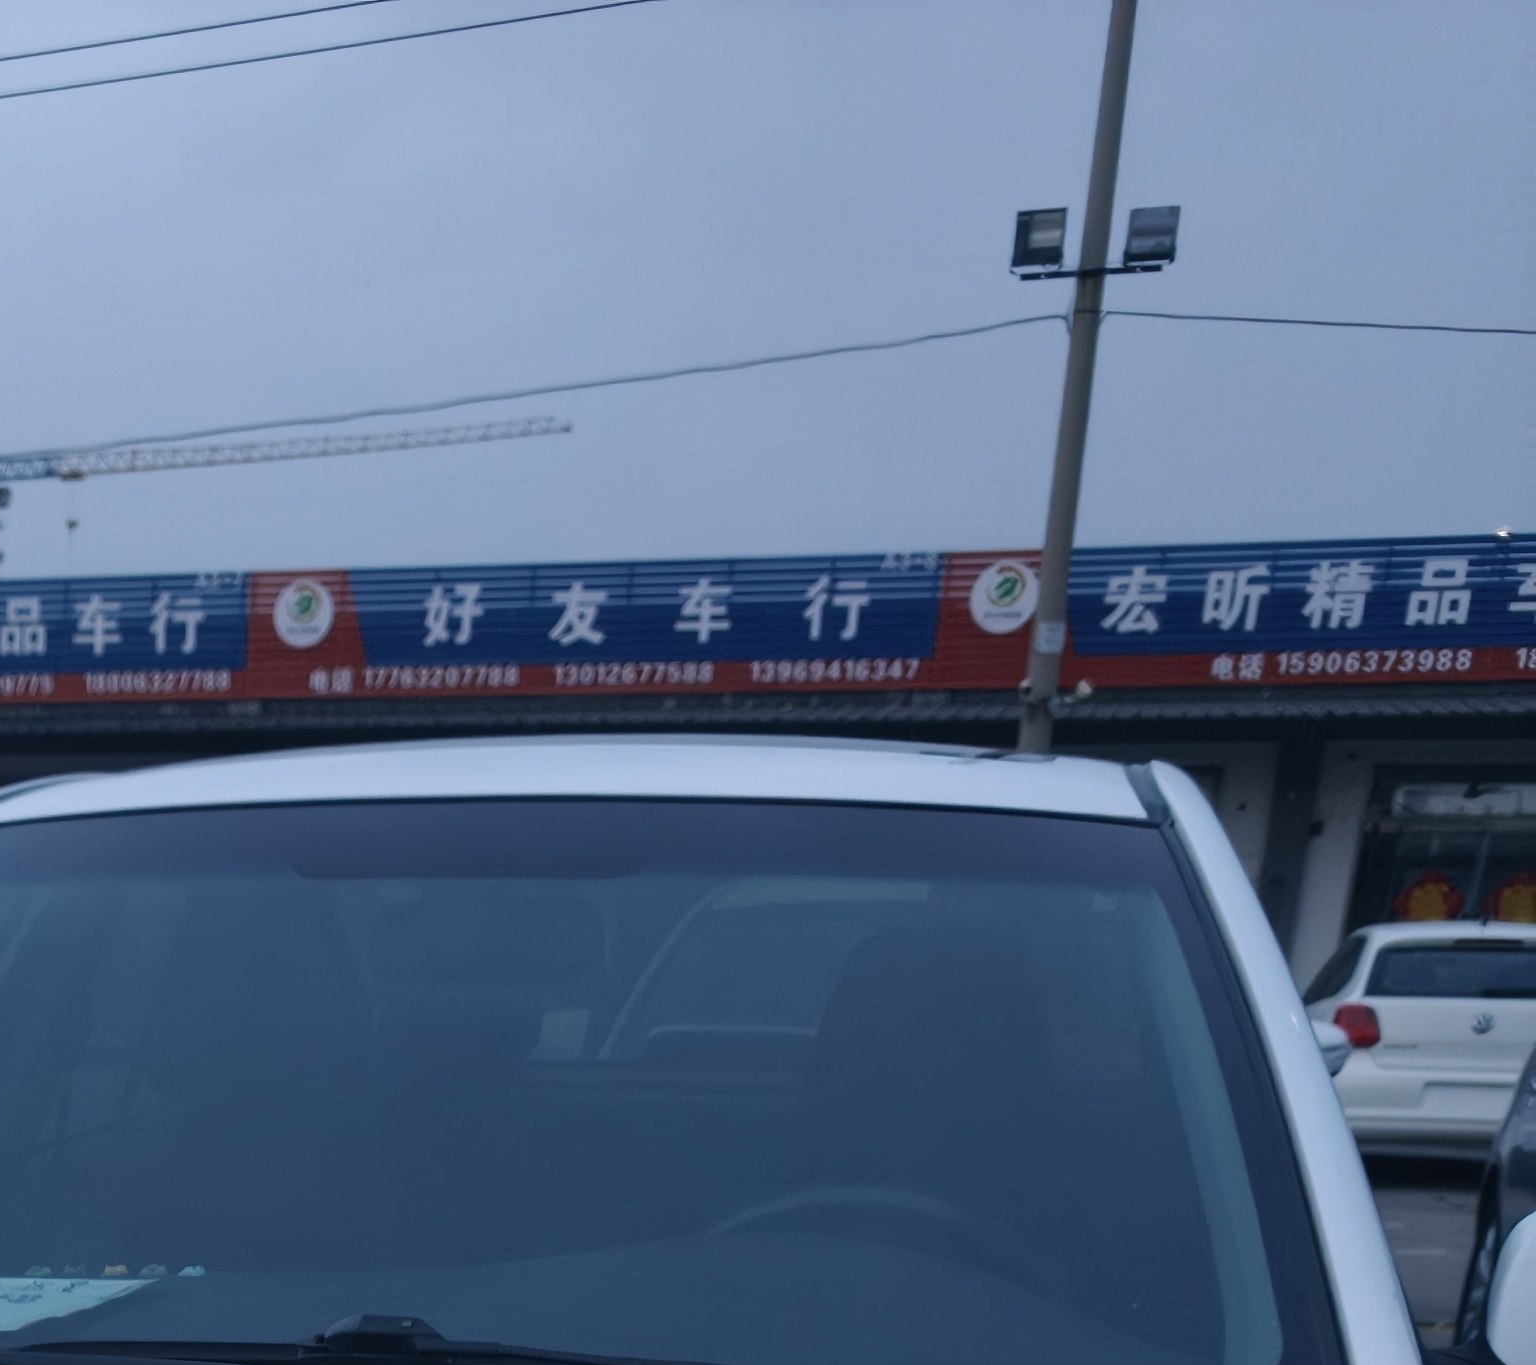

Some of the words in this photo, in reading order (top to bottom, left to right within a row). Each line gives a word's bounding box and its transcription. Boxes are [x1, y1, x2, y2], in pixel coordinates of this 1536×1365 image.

[423, 574, 870, 647] 好友车行
[1277, 648, 1473, 675] 15906373988
